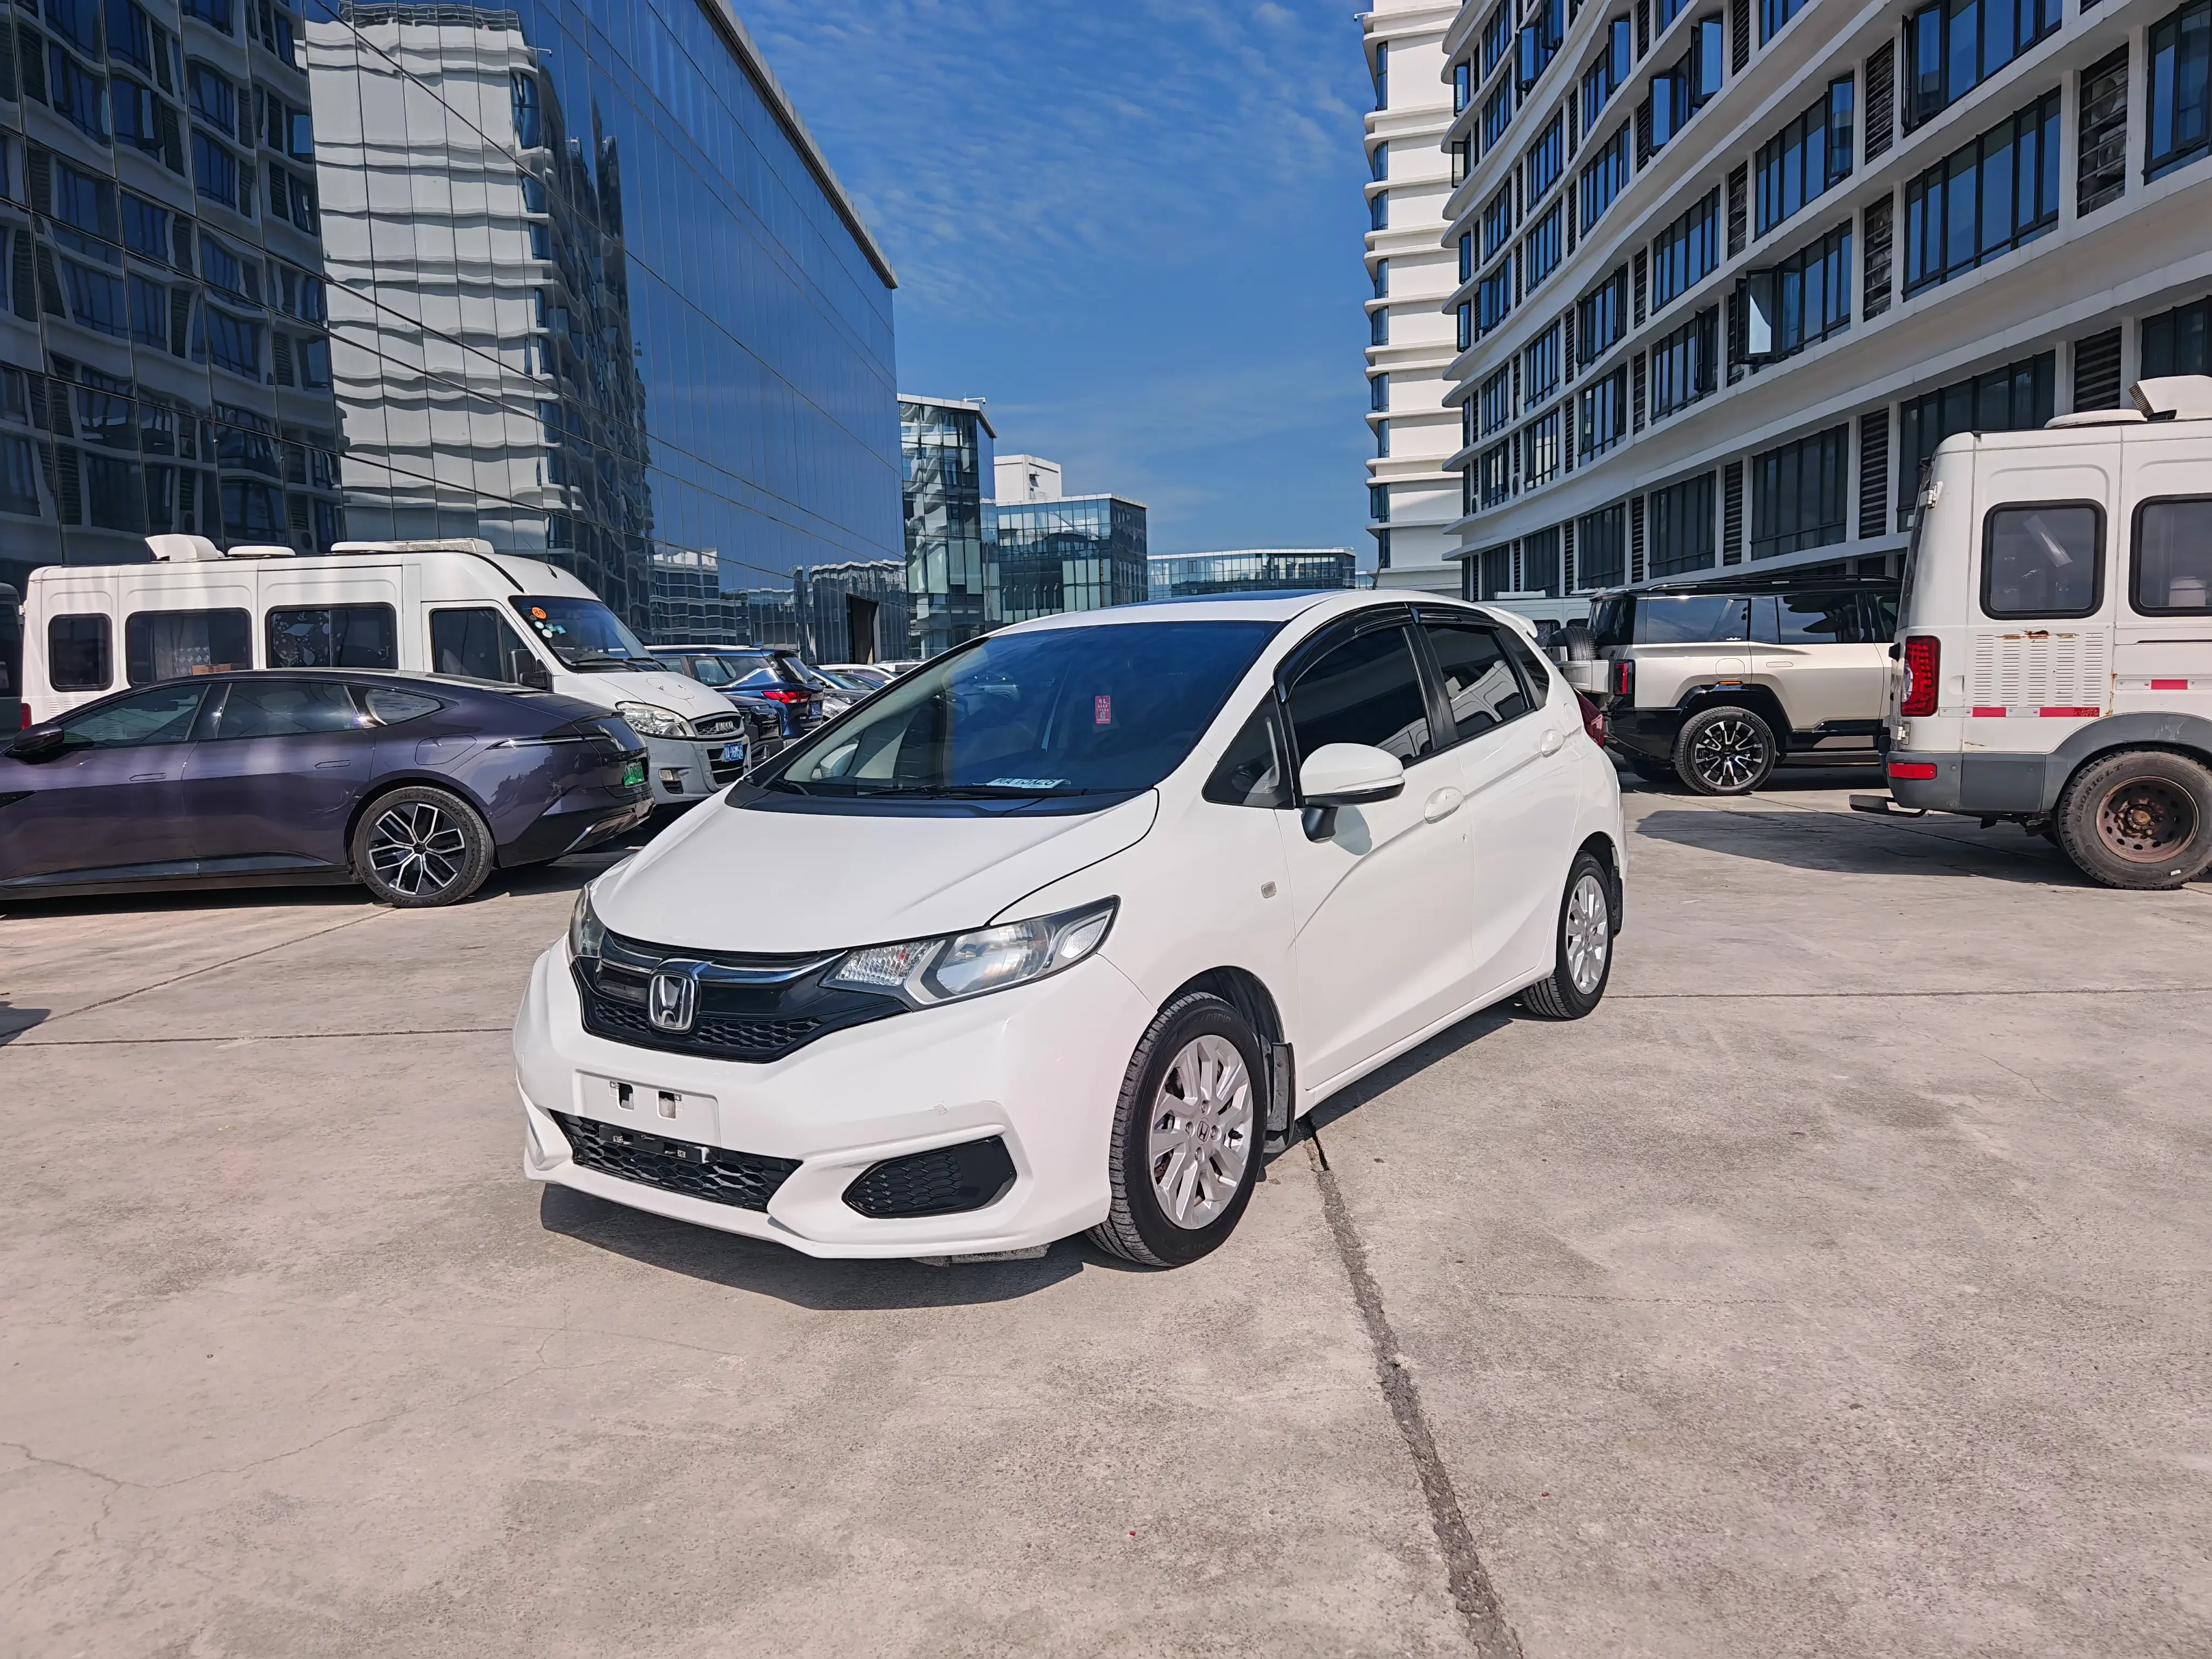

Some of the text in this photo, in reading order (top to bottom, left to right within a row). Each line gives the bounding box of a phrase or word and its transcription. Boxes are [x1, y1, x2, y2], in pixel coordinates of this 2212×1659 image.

[1750, 718, 1769, 737] MICHELIN
[423, 794, 463, 817] DUNLOP
[370, 881, 411, 903] DUNLOP
